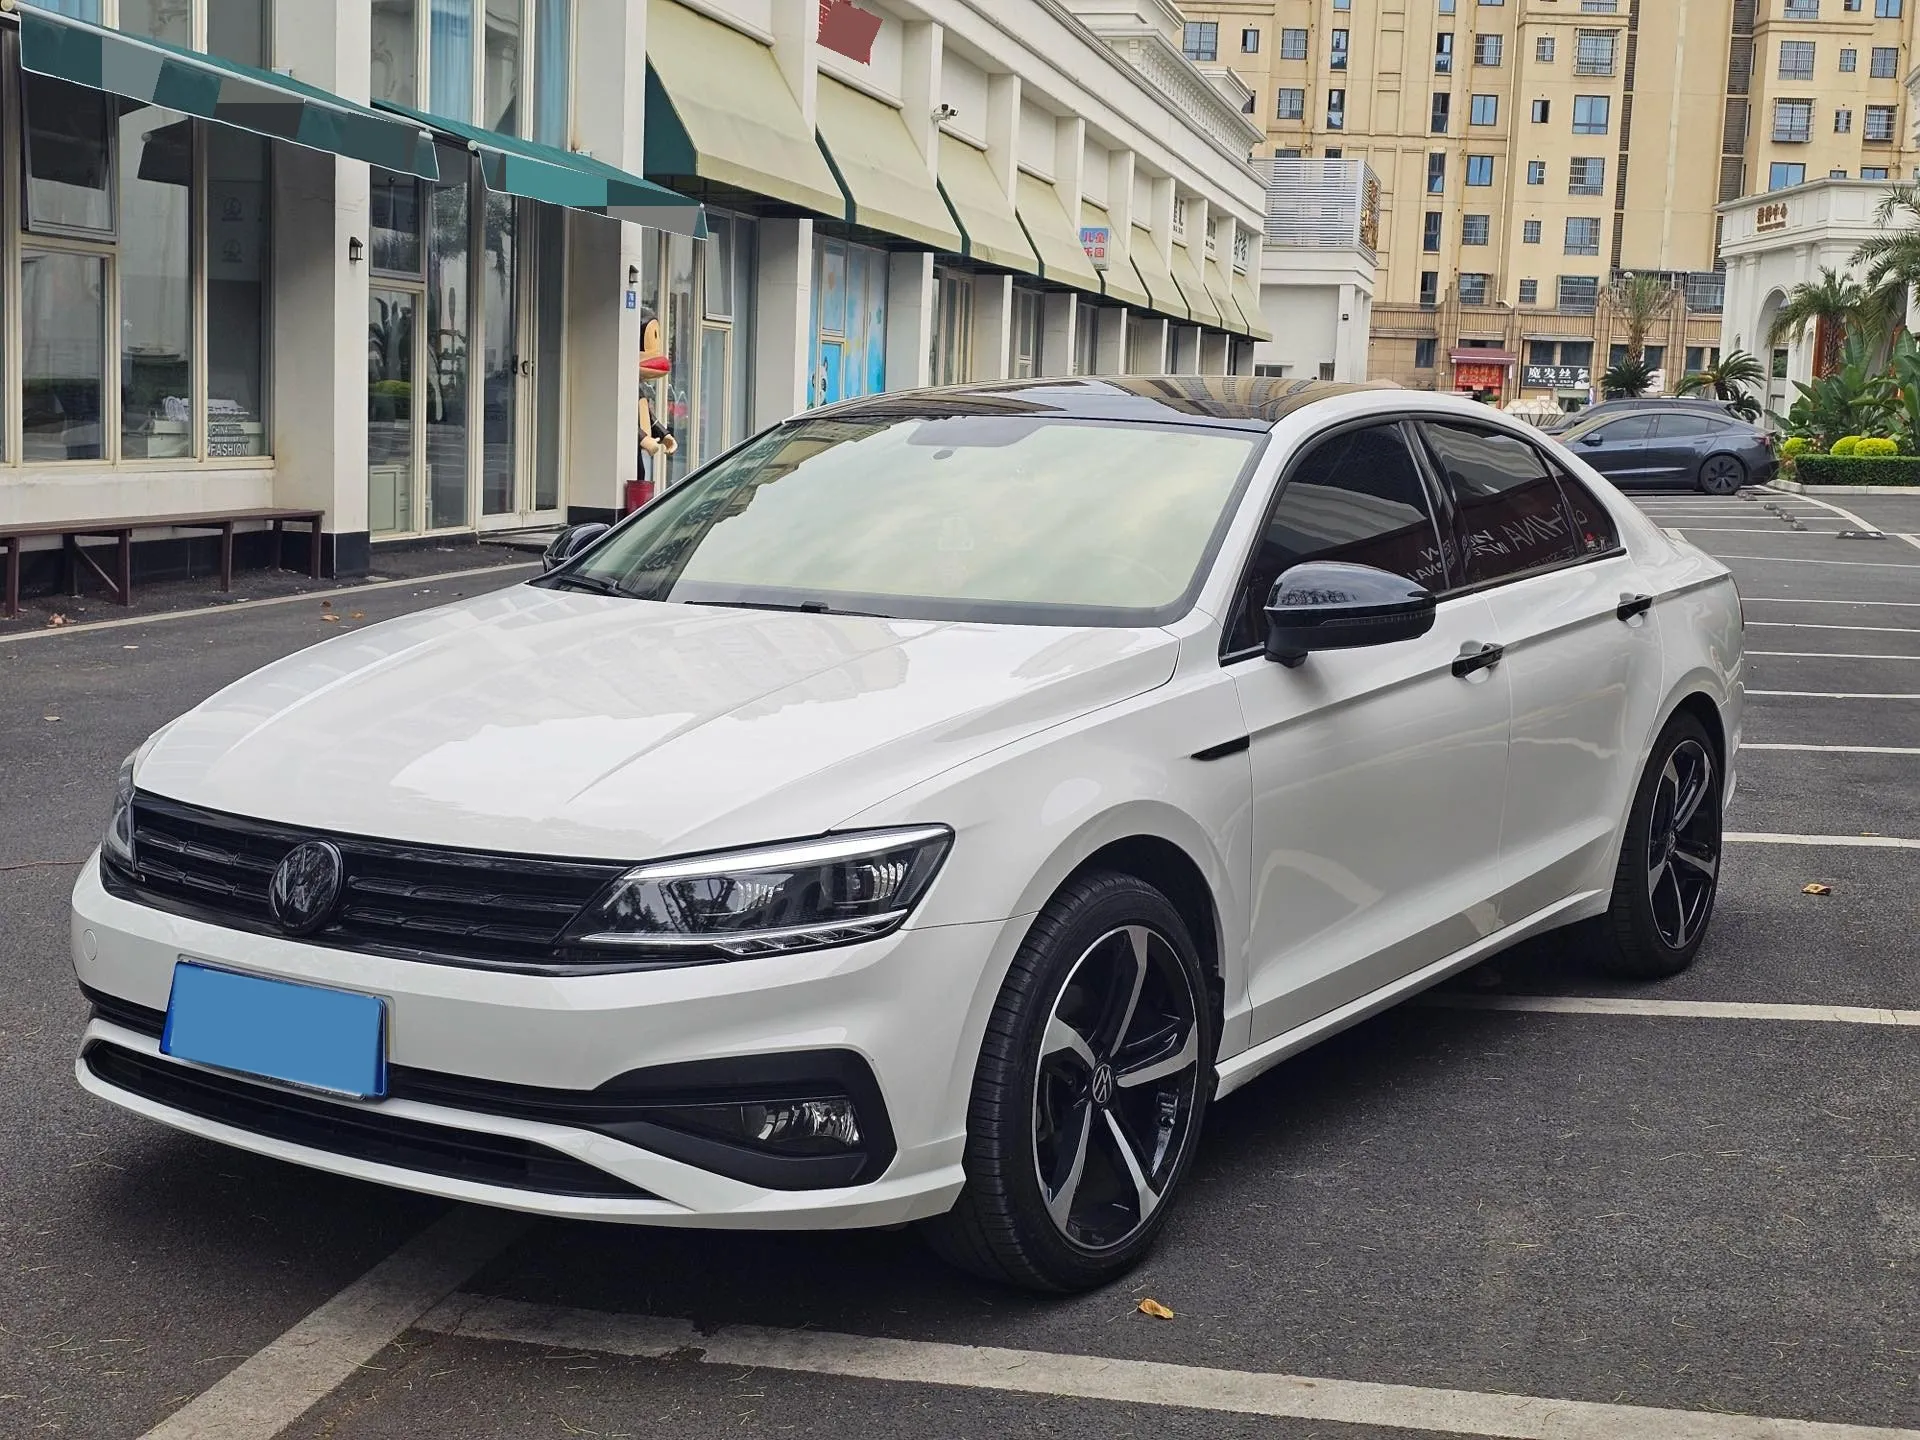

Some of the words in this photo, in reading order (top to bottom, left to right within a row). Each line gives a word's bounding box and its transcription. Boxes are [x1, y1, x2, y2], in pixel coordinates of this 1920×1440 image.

[1083, 231, 1105, 243] 儿童
[1083, 247, 1105, 257] 乐园
[1528, 367, 1571, 379] 魔发丝
[211, 443, 248, 456] FASHION
